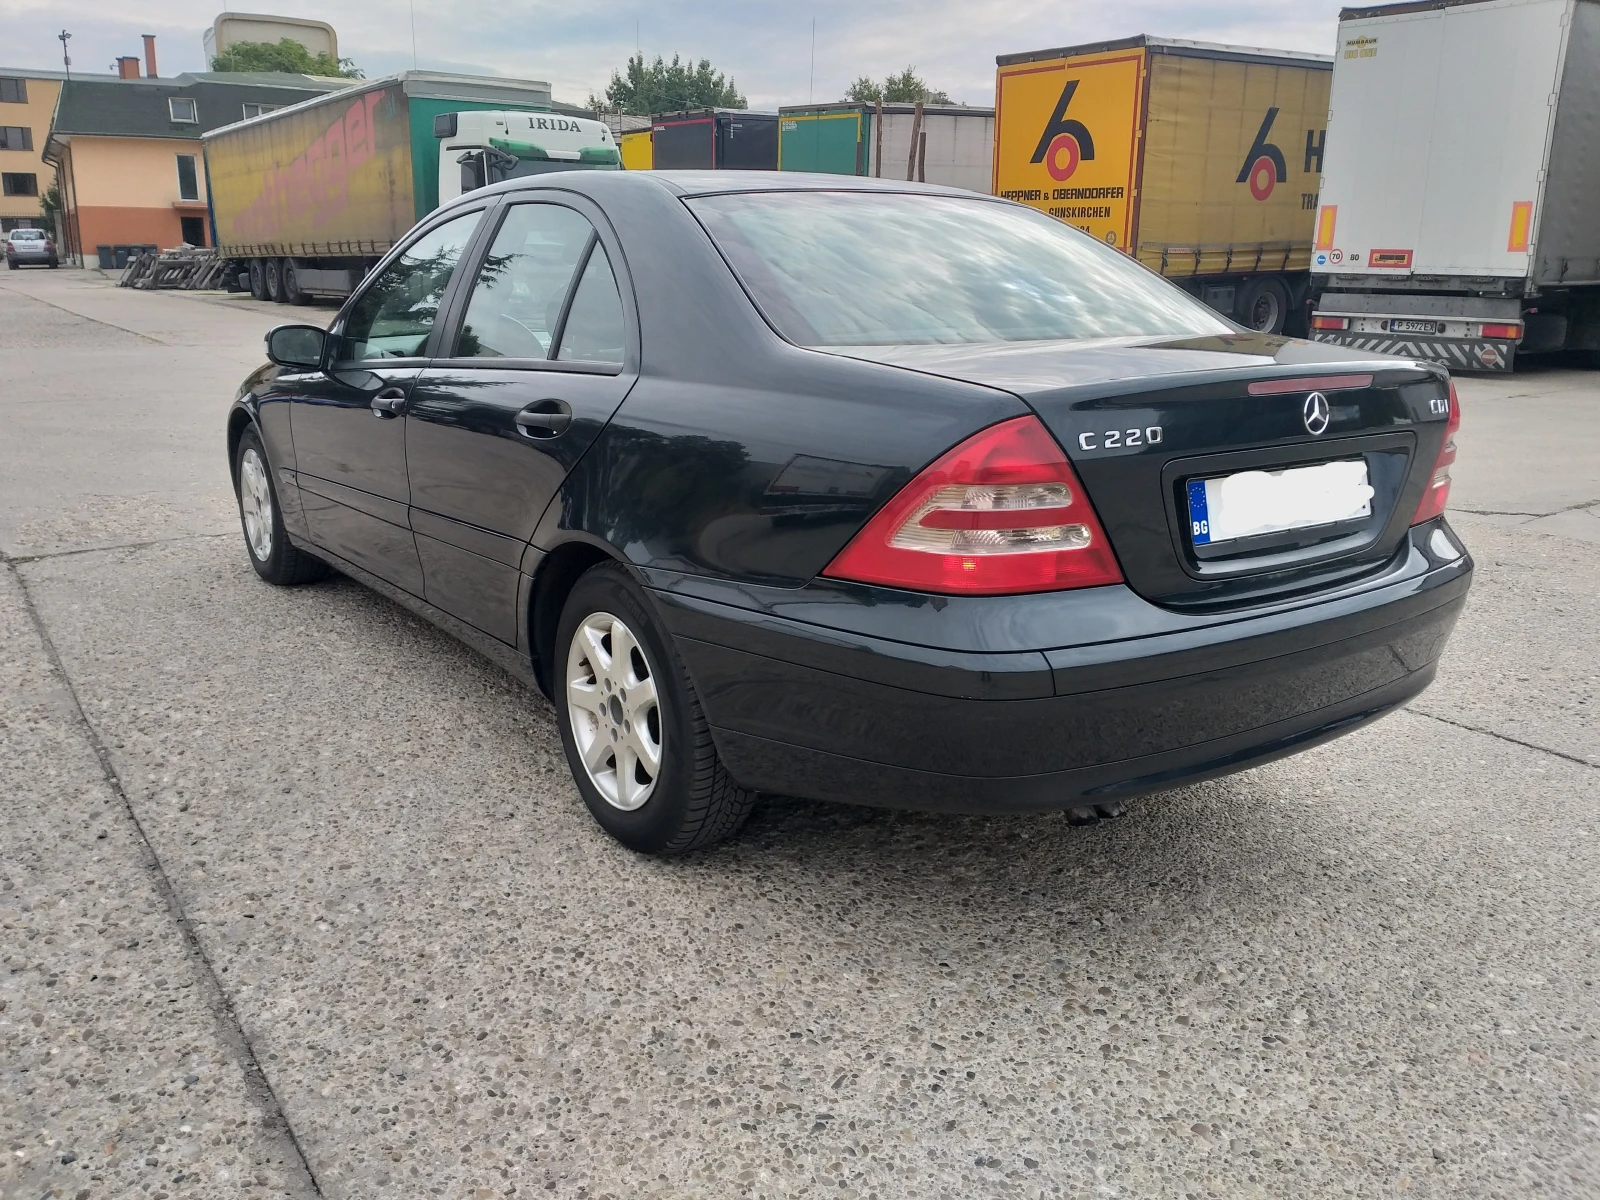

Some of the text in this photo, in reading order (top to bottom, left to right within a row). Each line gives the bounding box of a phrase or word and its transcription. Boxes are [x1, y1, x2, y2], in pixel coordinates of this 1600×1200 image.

[528, 117, 582, 132] IRIDA
[1001, 187, 1124, 201] HEPPNER & OBERNDORFER
[1048, 206, 1111, 218] GUNSKIRCHEN
[1398, 321, 1403, 329] P
[1430, 399, 1449, 414] CDI
[1079, 426, 1163, 451] C 220
[1192, 520, 1209, 536] BG
